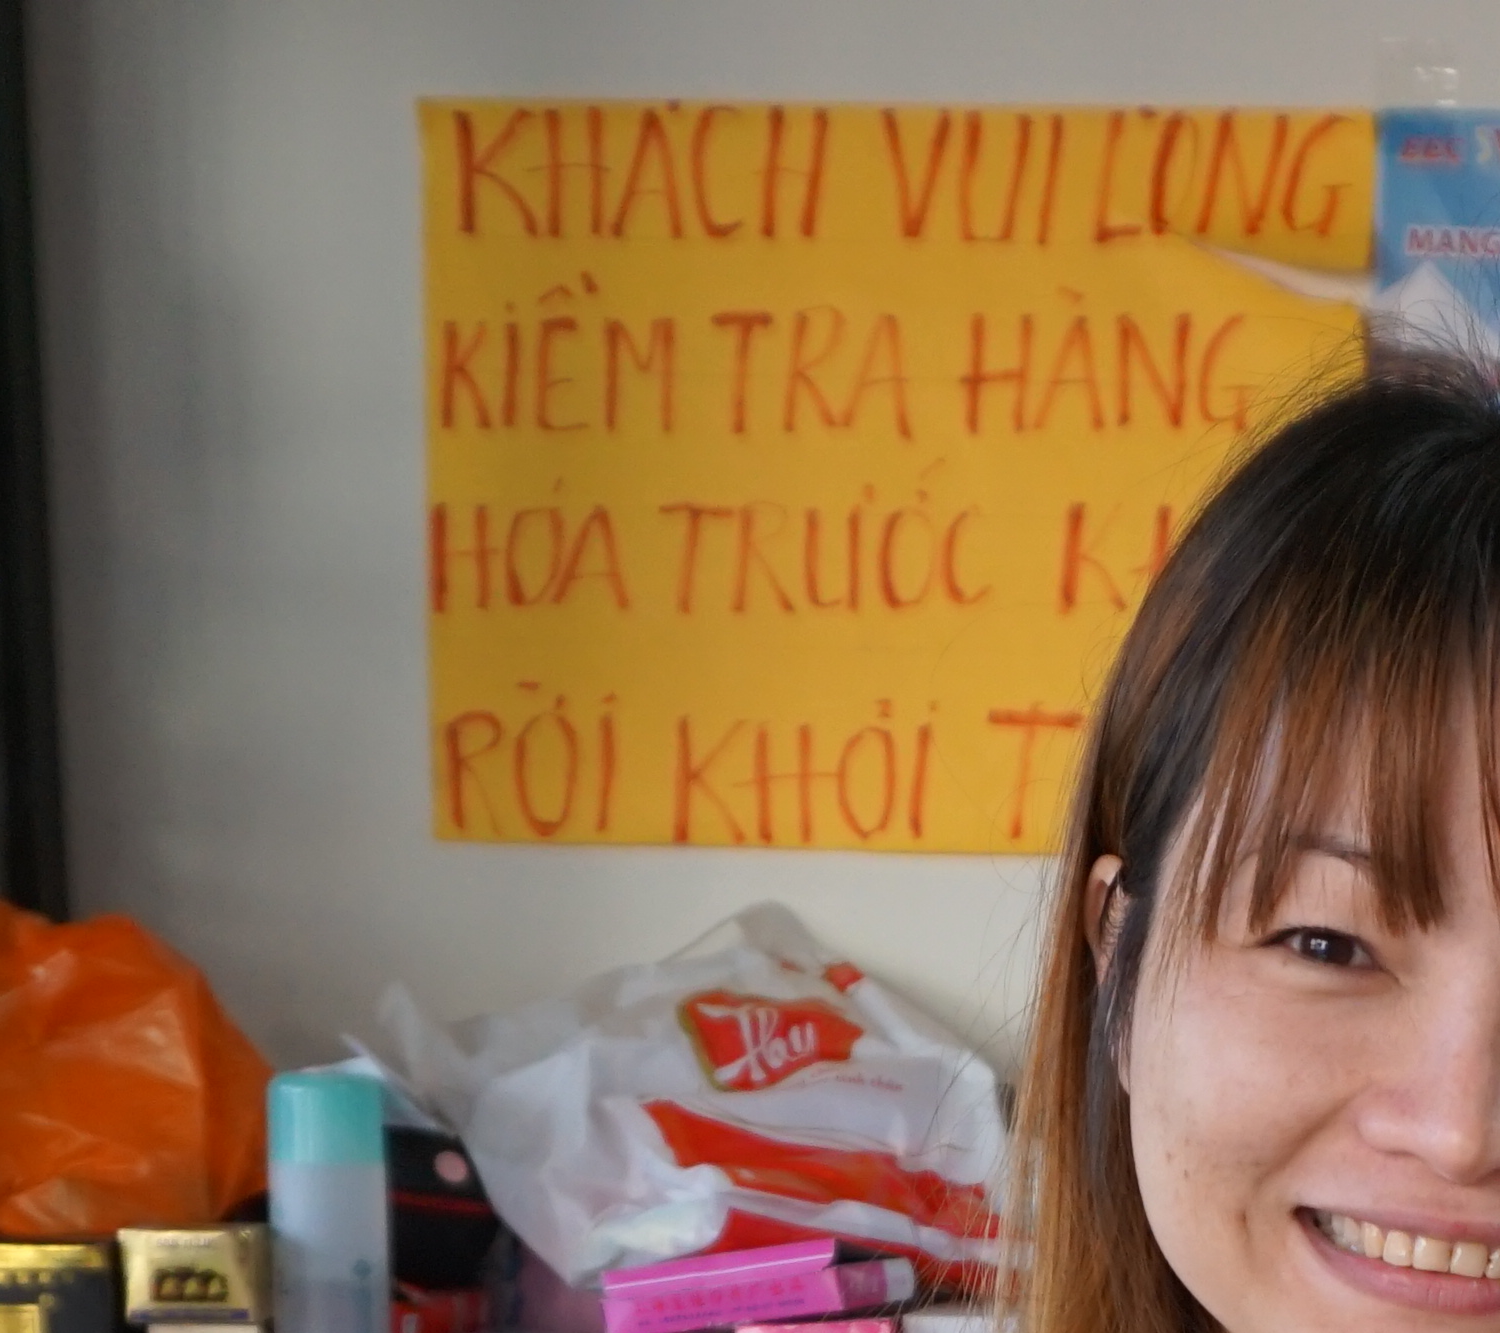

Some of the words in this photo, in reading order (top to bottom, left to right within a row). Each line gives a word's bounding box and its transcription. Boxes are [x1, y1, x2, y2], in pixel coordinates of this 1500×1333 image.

[882, 108, 1065, 246] VUI
[1406, 226, 1500, 256] MANG
[711, 304, 914, 442] TRA
